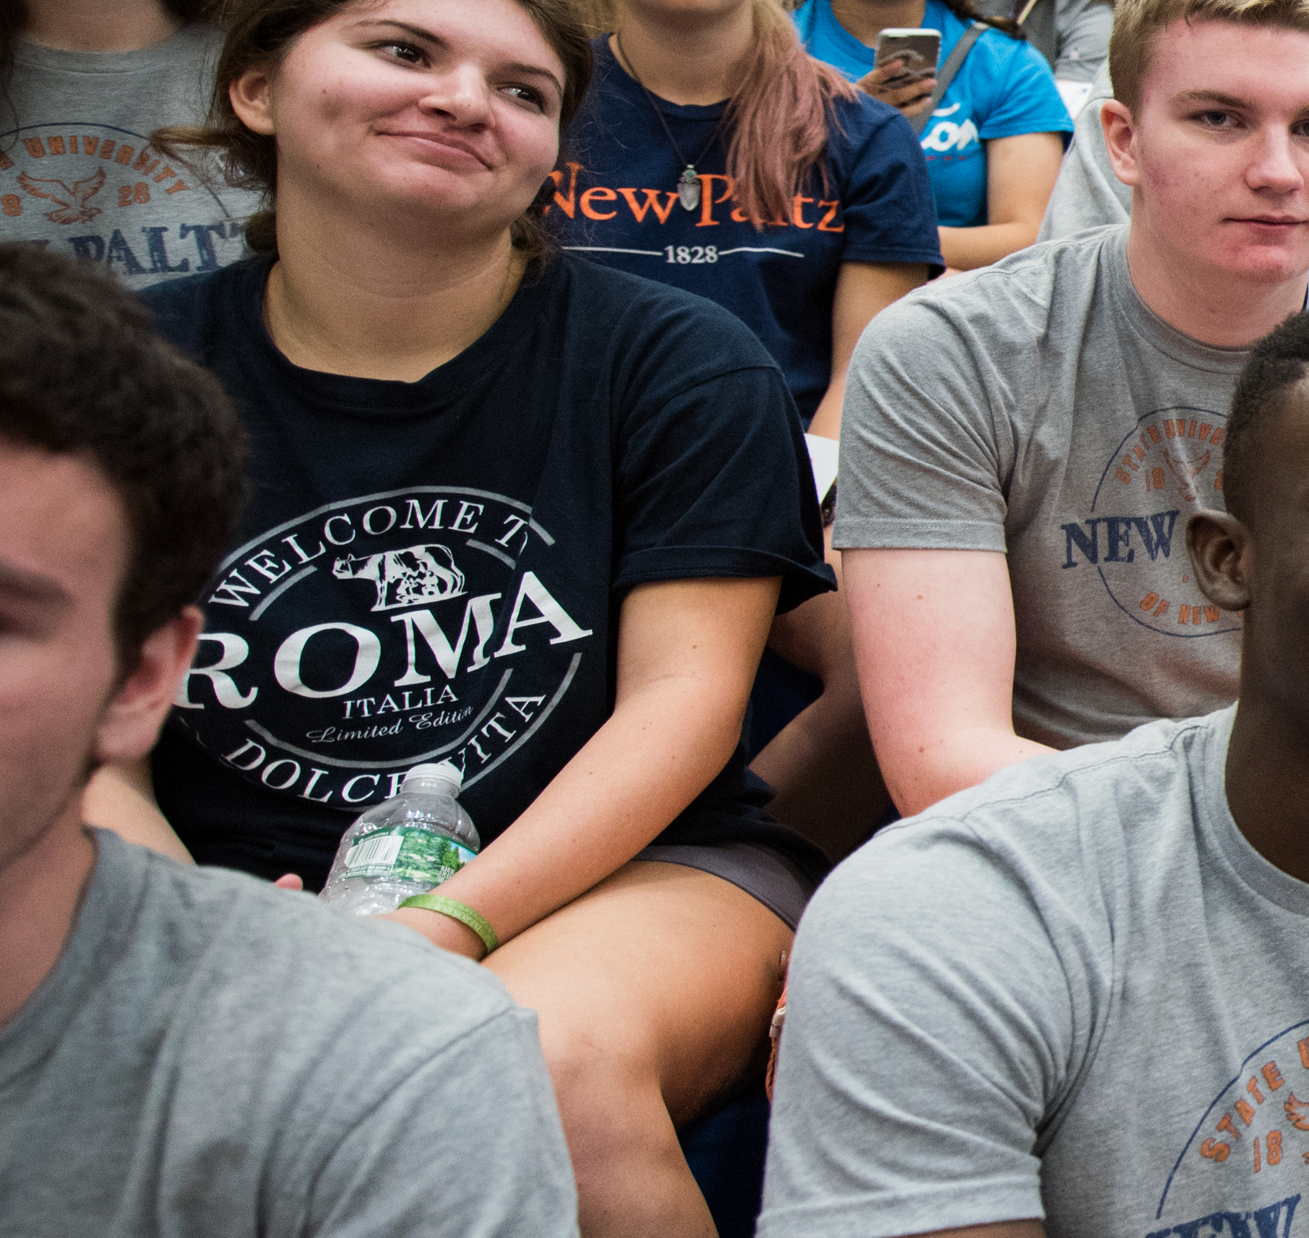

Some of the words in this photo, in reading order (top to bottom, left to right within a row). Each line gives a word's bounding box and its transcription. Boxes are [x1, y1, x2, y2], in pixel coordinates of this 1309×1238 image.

[24, 136, 189, 194] UNIVERSITY
[118, 181, 151, 207] 28
[543, 162, 680, 225] New
[695, 174, 845, 233] Ptz
[69, 222, 245, 275] PALT
[663, 245, 719, 264] 1828
[209, 500, 484, 612] WELCOME
[1061, 510, 1181, 569] NEW
[1139, 592, 1170, 617] OF
[1178, 604, 1220, 625] NEW
[176, 571, 594, 710] ROMA
[342, 684, 459, 720] ITALIA
[305, 718, 404, 744] Limited
[1200, 1060, 1285, 1164] STATE
[1252, 1129, 1284, 1174] 18
